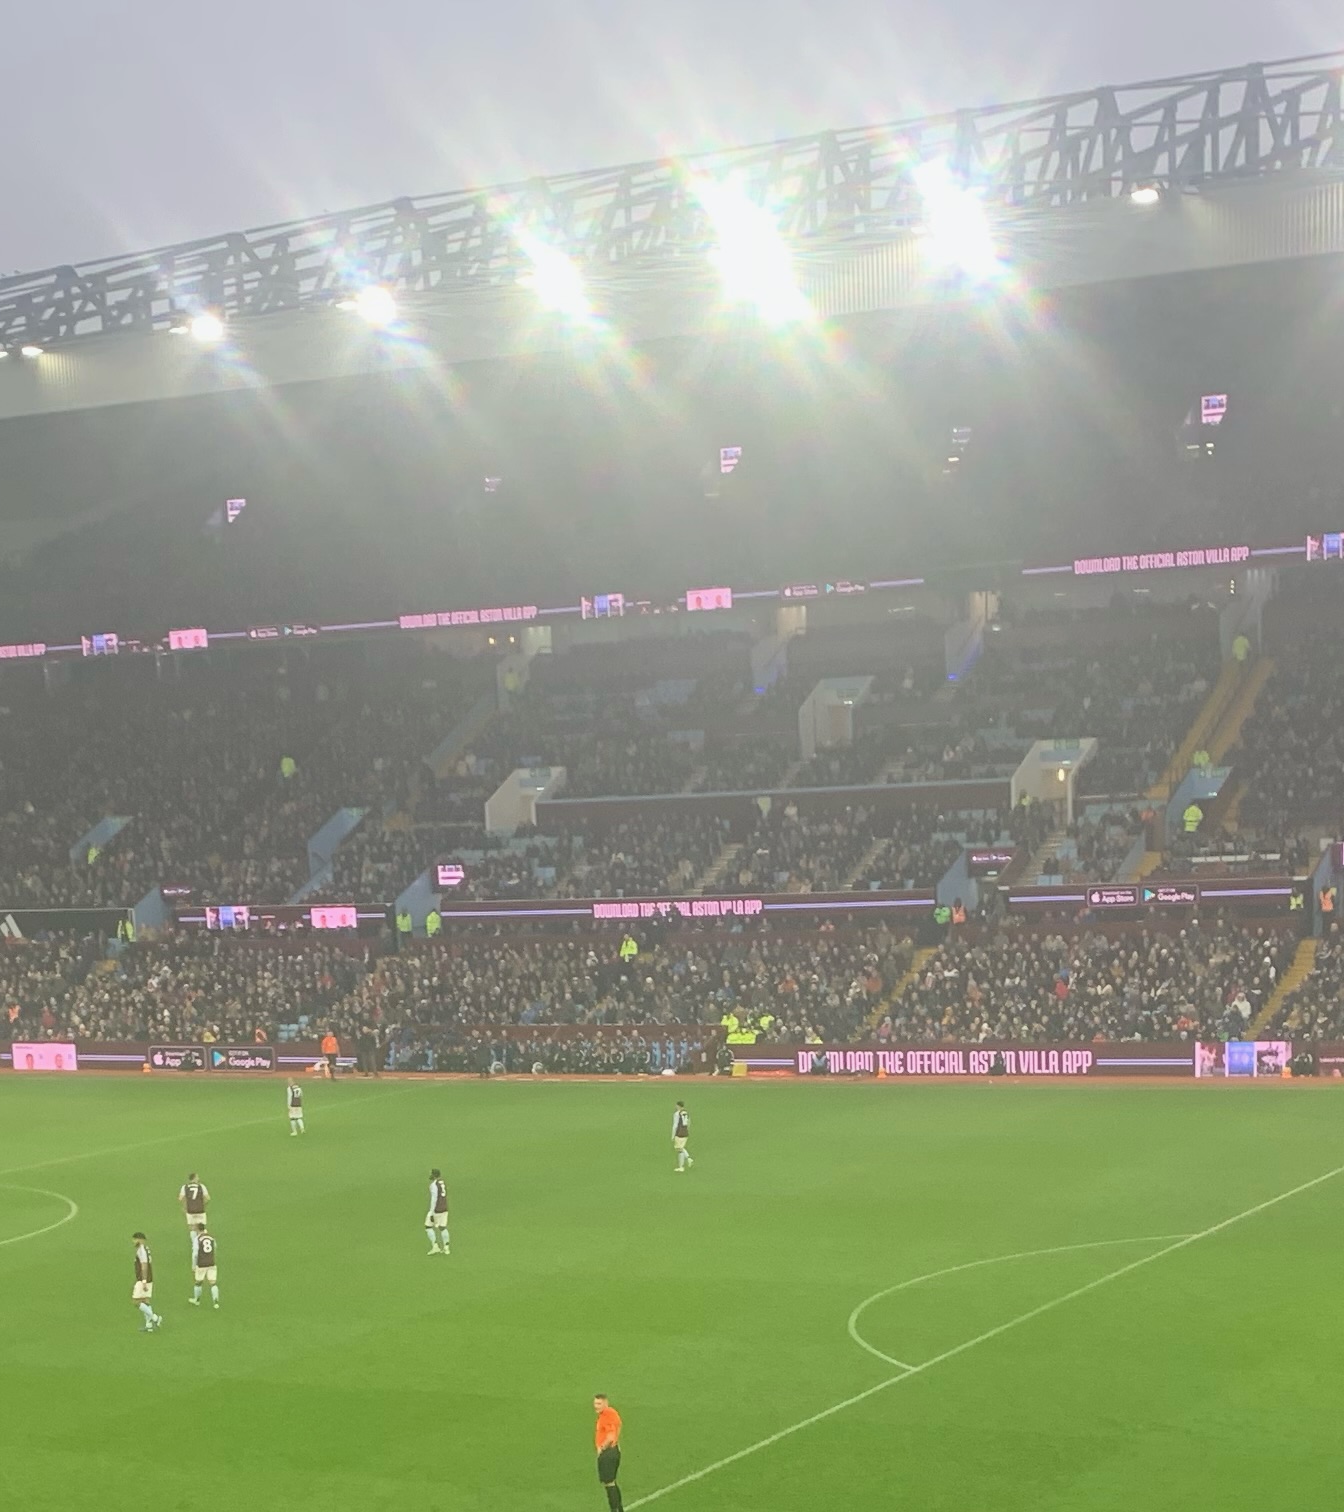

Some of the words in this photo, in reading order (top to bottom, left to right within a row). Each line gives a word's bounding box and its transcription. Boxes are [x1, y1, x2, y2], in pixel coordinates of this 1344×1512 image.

[1122, 555, 1139, 570] THE
[1140, 553, 1176, 569] OFFICIAL
[1176, 551, 1204, 566] ASTON
[1206, 548, 1230, 564] VILLA
[1231, 546, 1249, 561] APP
[876, 1050, 904, 1073] THE
[906, 1050, 967, 1074] OFFICIAL
[969, 1050, 1017, 1074] ASTN
[1019, 1050, 1059, 1074] VILLA
[1062, 1050, 1092, 1074] APP
[189, 1187, 199, 1200] 7
[202, 1238, 213, 1253] 8
